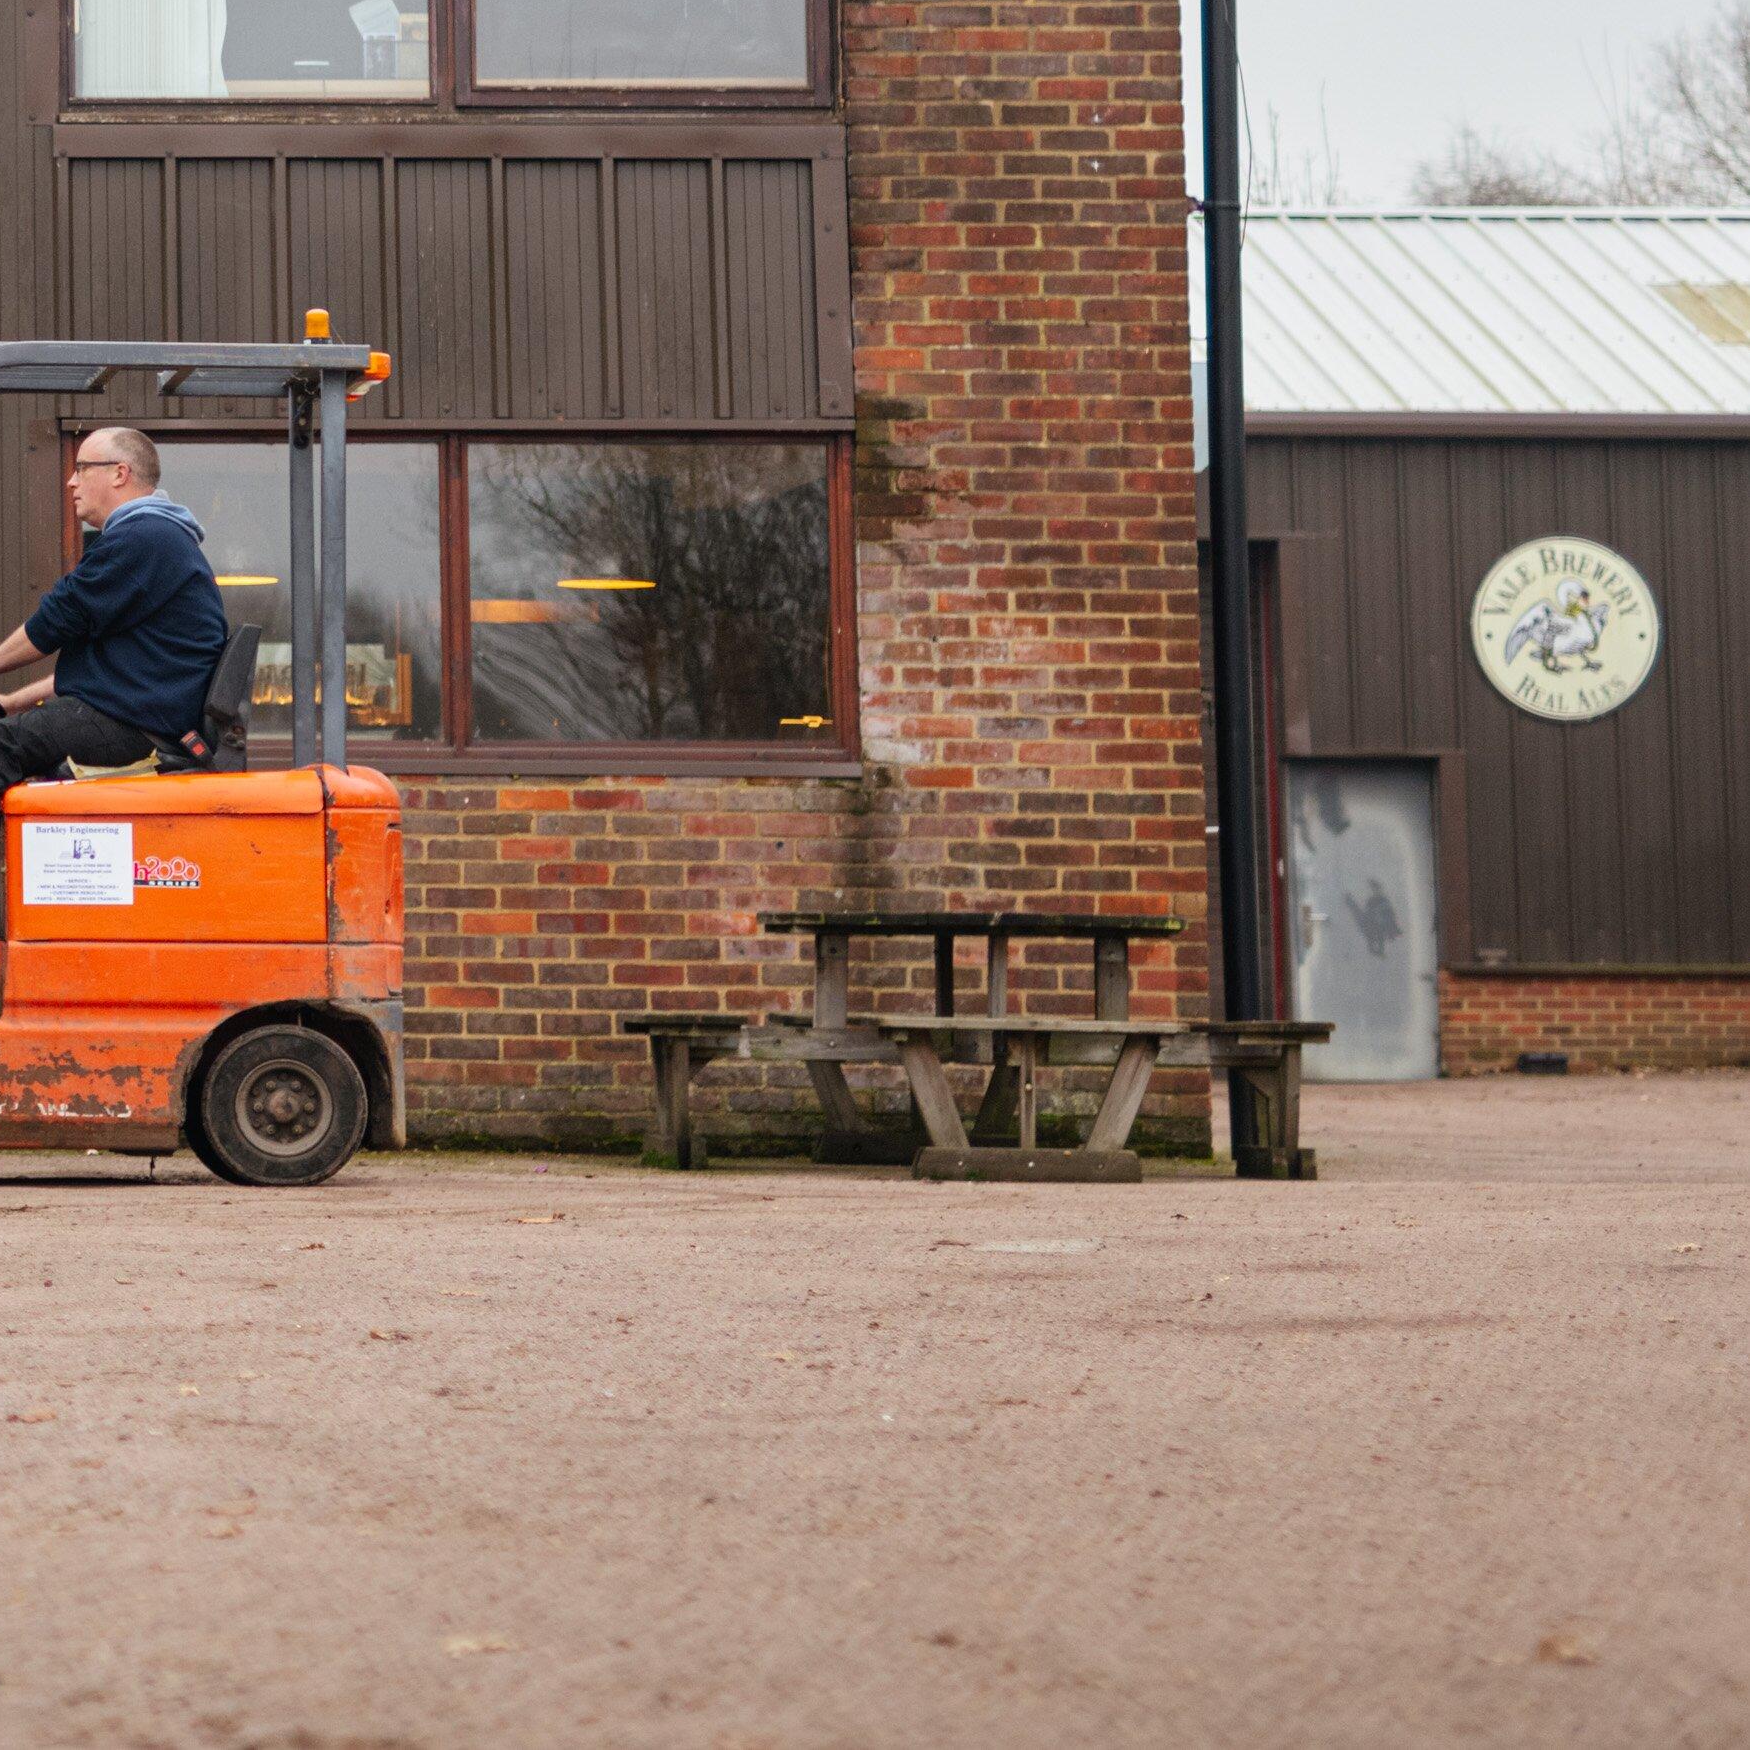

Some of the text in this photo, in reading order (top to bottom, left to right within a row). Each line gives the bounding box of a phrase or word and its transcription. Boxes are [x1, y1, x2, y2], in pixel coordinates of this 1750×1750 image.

[1482, 547, 1642, 618] VALE BREWERY
[1515, 675, 1629, 712] REAL ALES
[35, 826, 120, 835] Barkley Engineering
